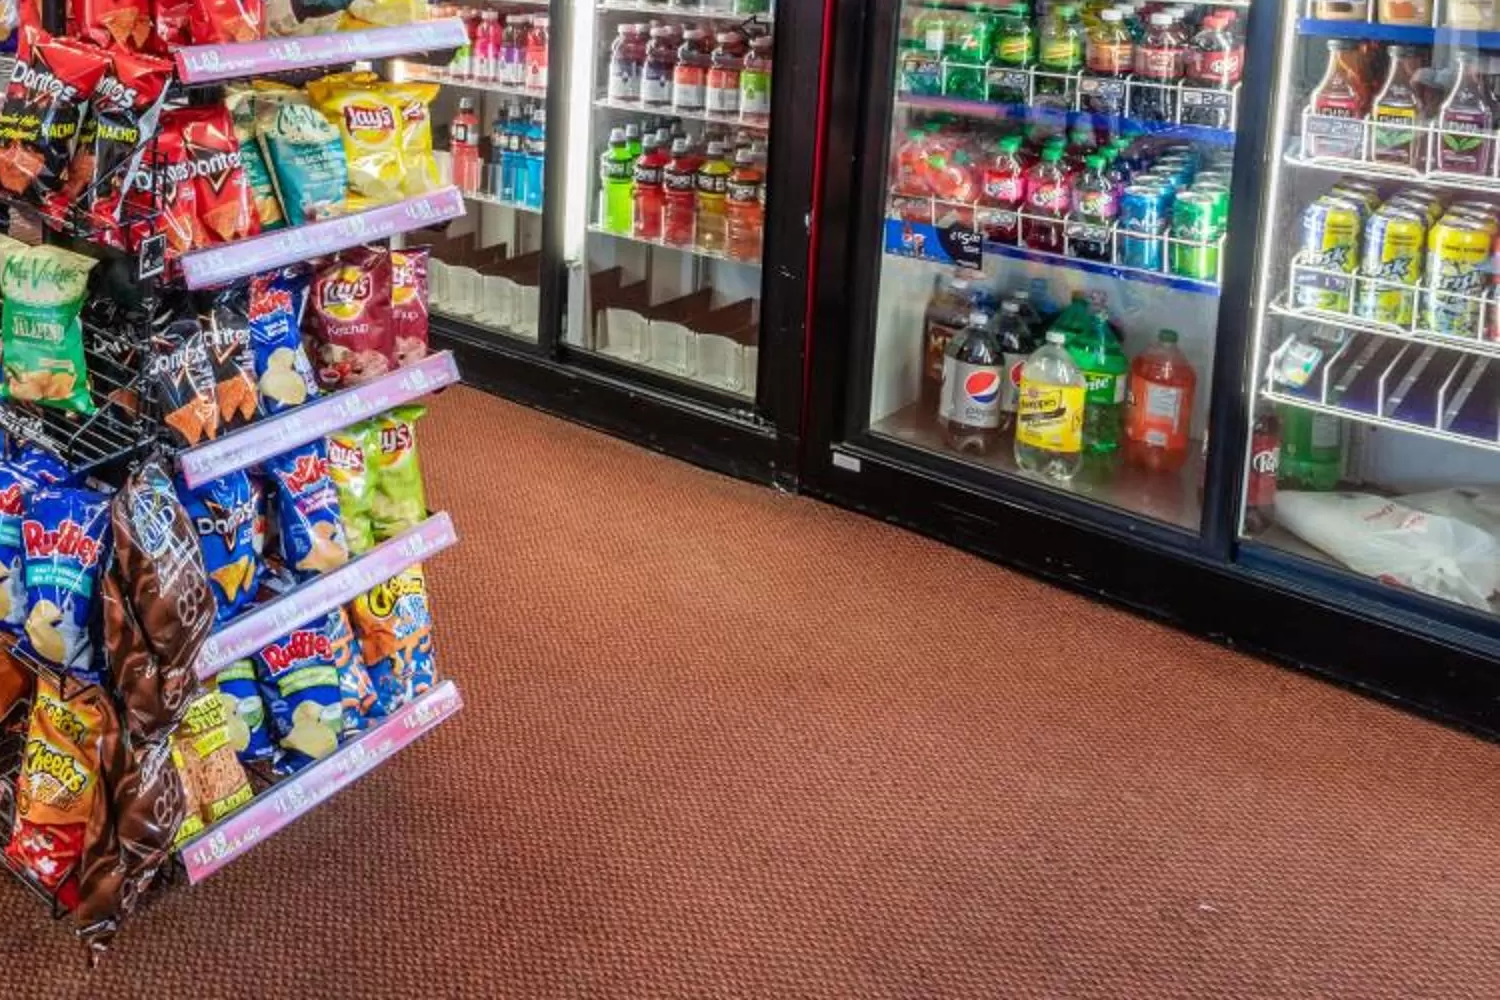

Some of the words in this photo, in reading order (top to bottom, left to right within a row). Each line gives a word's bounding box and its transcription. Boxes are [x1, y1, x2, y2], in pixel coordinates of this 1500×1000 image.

[11, 60, 79, 102] Doritos
[322, 278, 370, 307] Lay's
[327, 323, 371, 338] Ketchup
[21, 519, 100, 569] Ruffles
[261, 630, 335, 676] Ruffles
[25, 739, 88, 794] Cheetos
